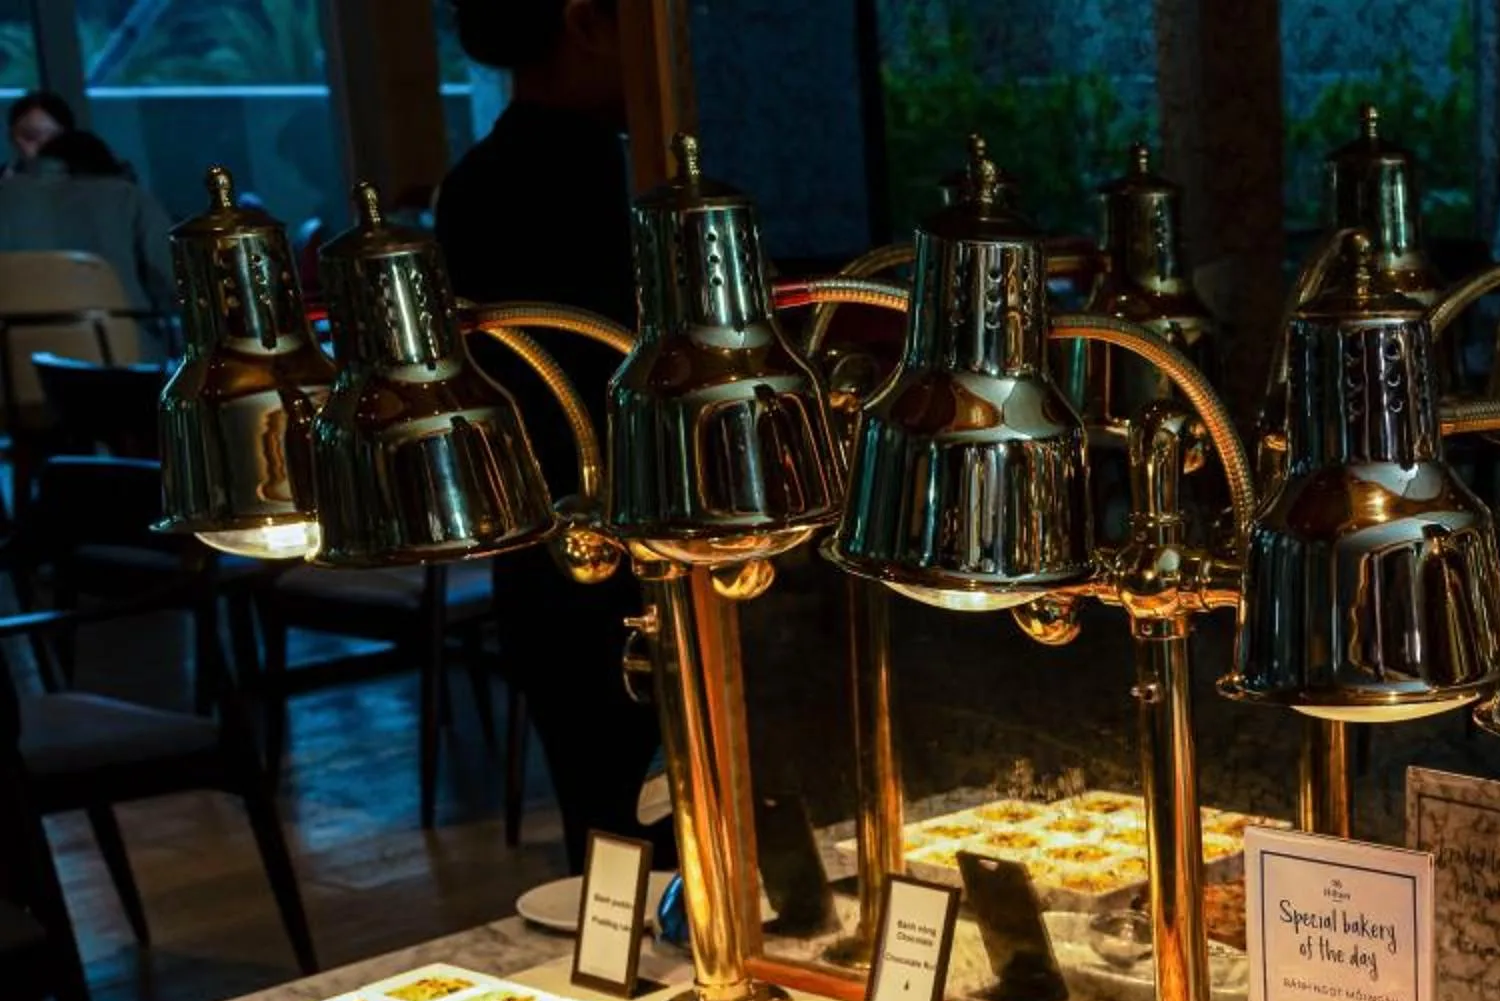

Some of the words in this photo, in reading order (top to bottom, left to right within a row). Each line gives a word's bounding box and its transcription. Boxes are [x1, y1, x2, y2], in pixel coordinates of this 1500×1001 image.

[1279, 899, 1336, 934] Special
[1343, 909, 1397, 954] bakery
[1299, 935, 1312, 960] of
[1319, 935, 1345, 963] the
[1349, 944, 1379, 982] day
